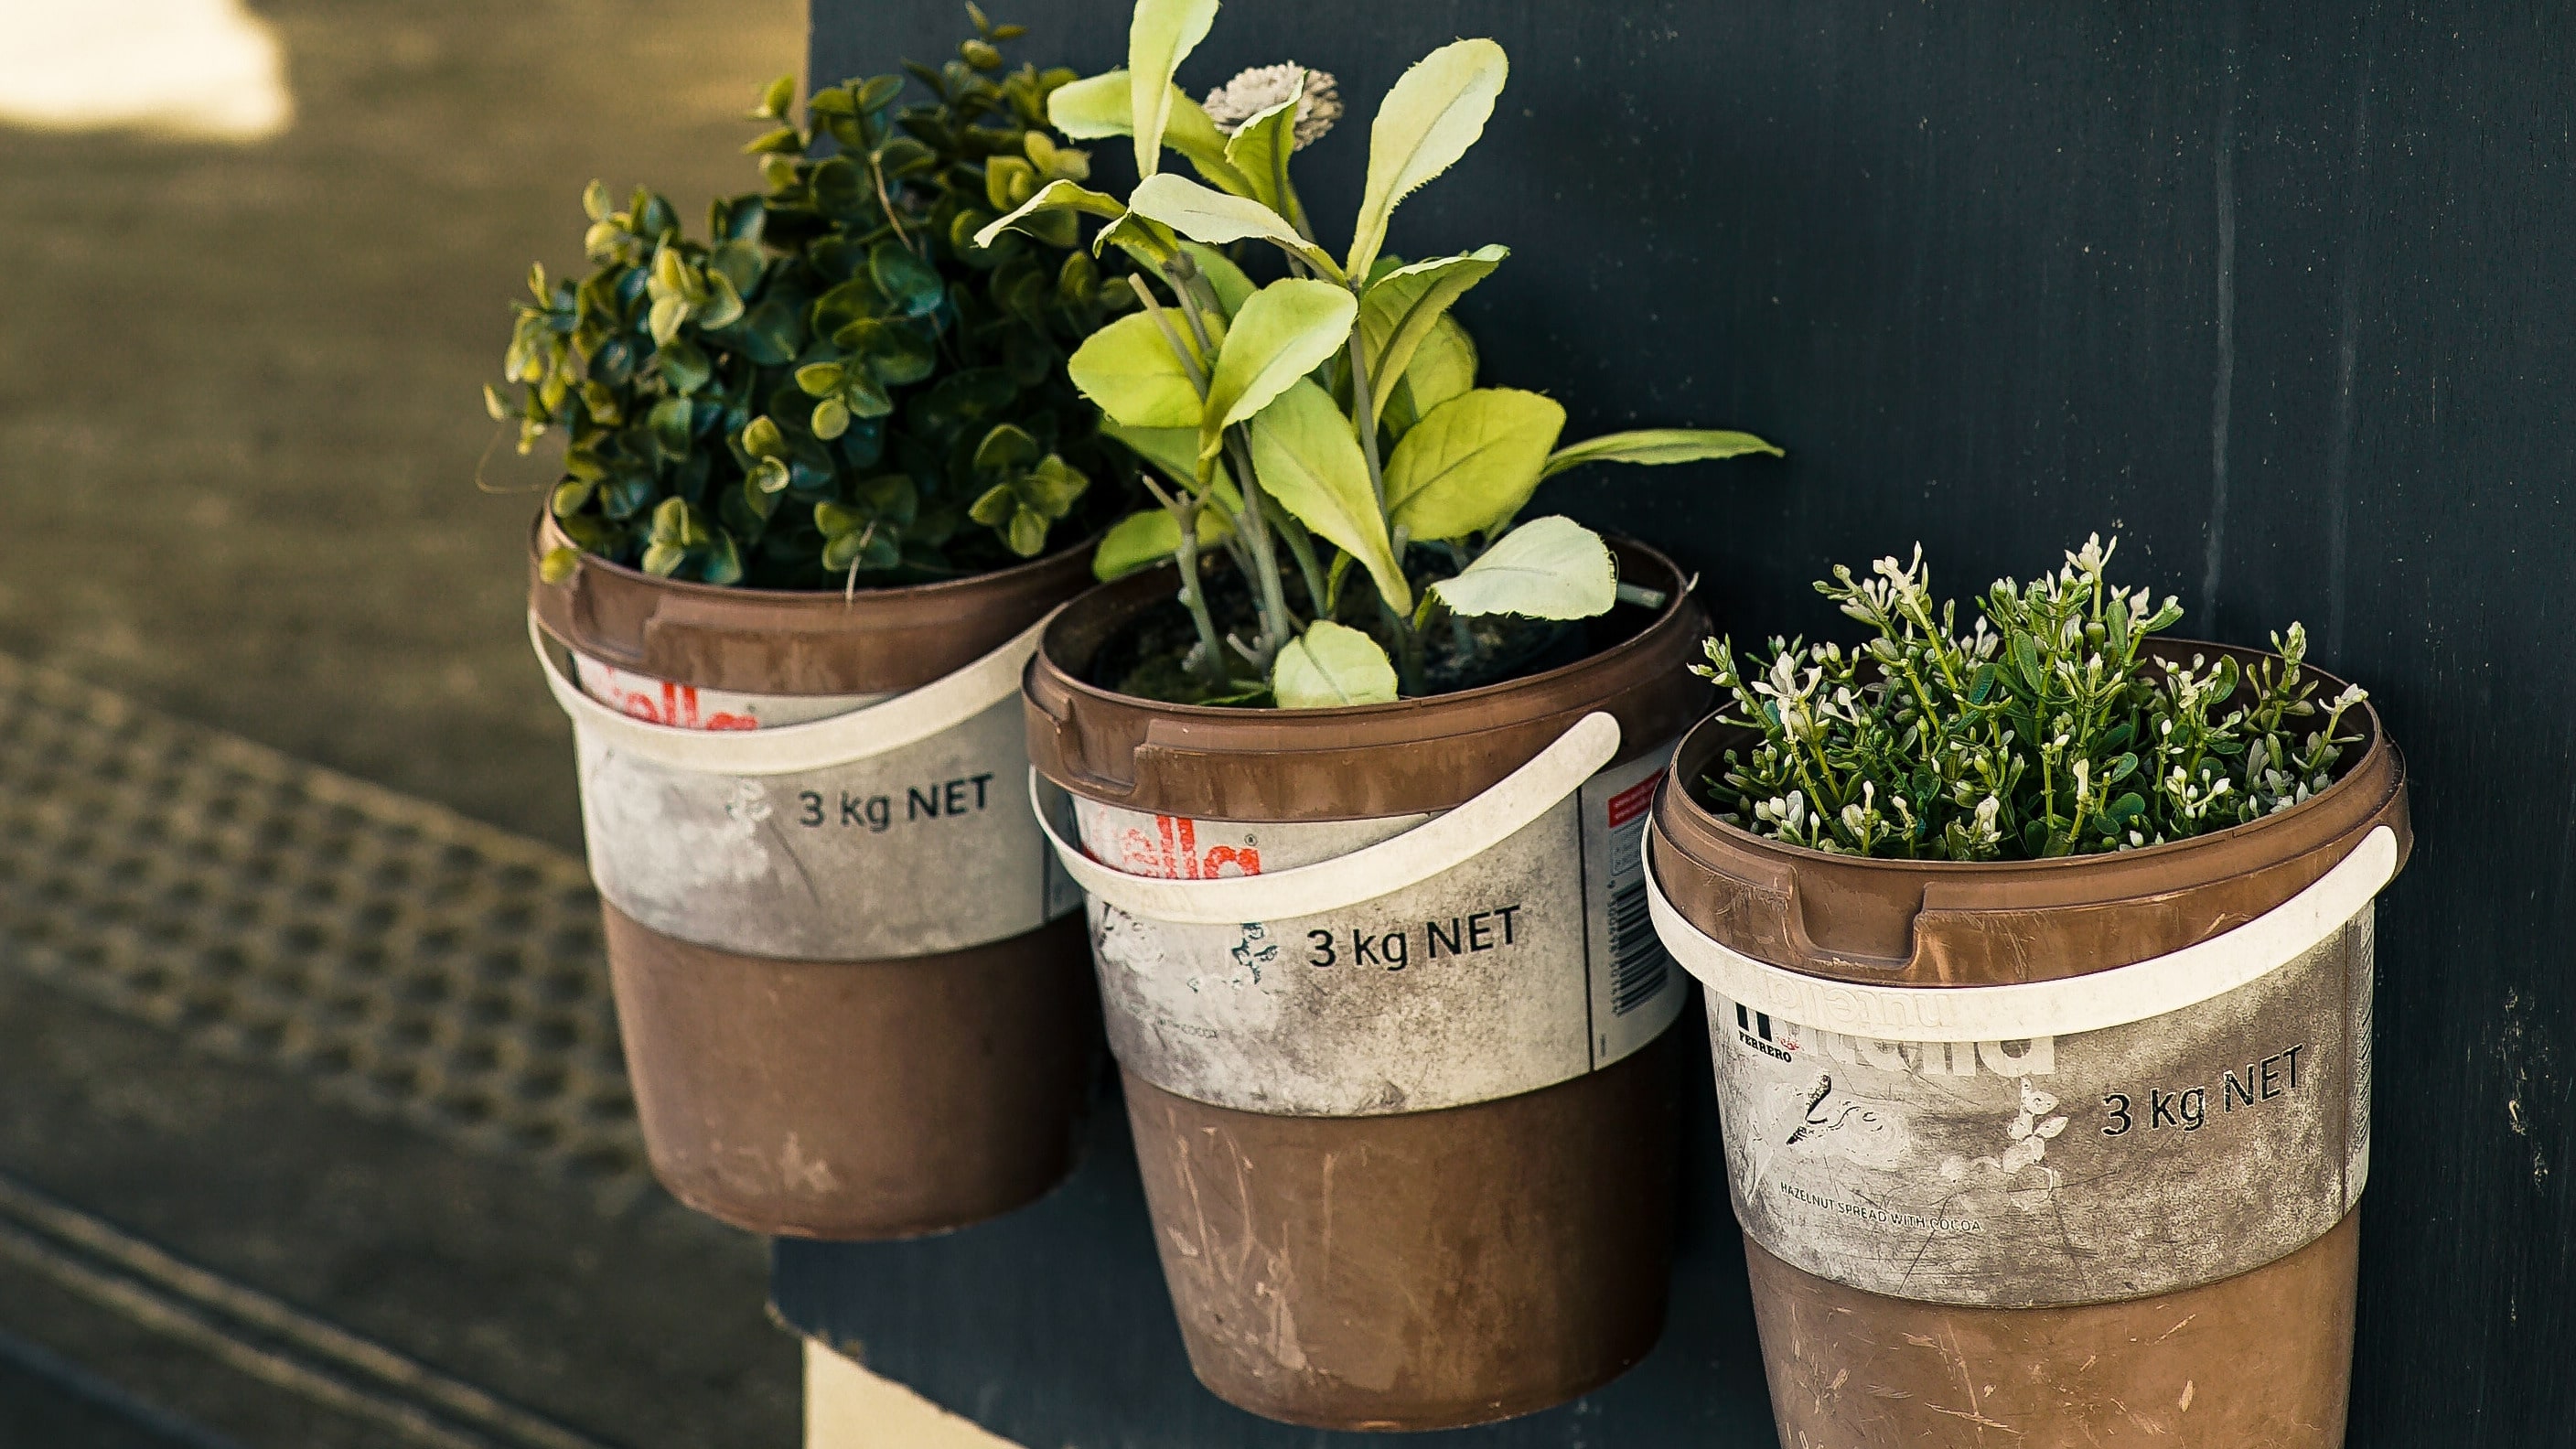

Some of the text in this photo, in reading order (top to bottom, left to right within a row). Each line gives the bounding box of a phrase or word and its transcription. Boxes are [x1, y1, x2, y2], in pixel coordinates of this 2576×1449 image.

[799, 771, 995, 834] 3 kg NET
[1306, 904, 1521, 971] 3 kg NET
[1738, 1012, 1793, 1064] FERRERO
[2101, 1043, 2304, 1136] 3 kg NET
[1780, 1181, 1984, 1233] HAZELNUT SPREAD WITH COCOA
